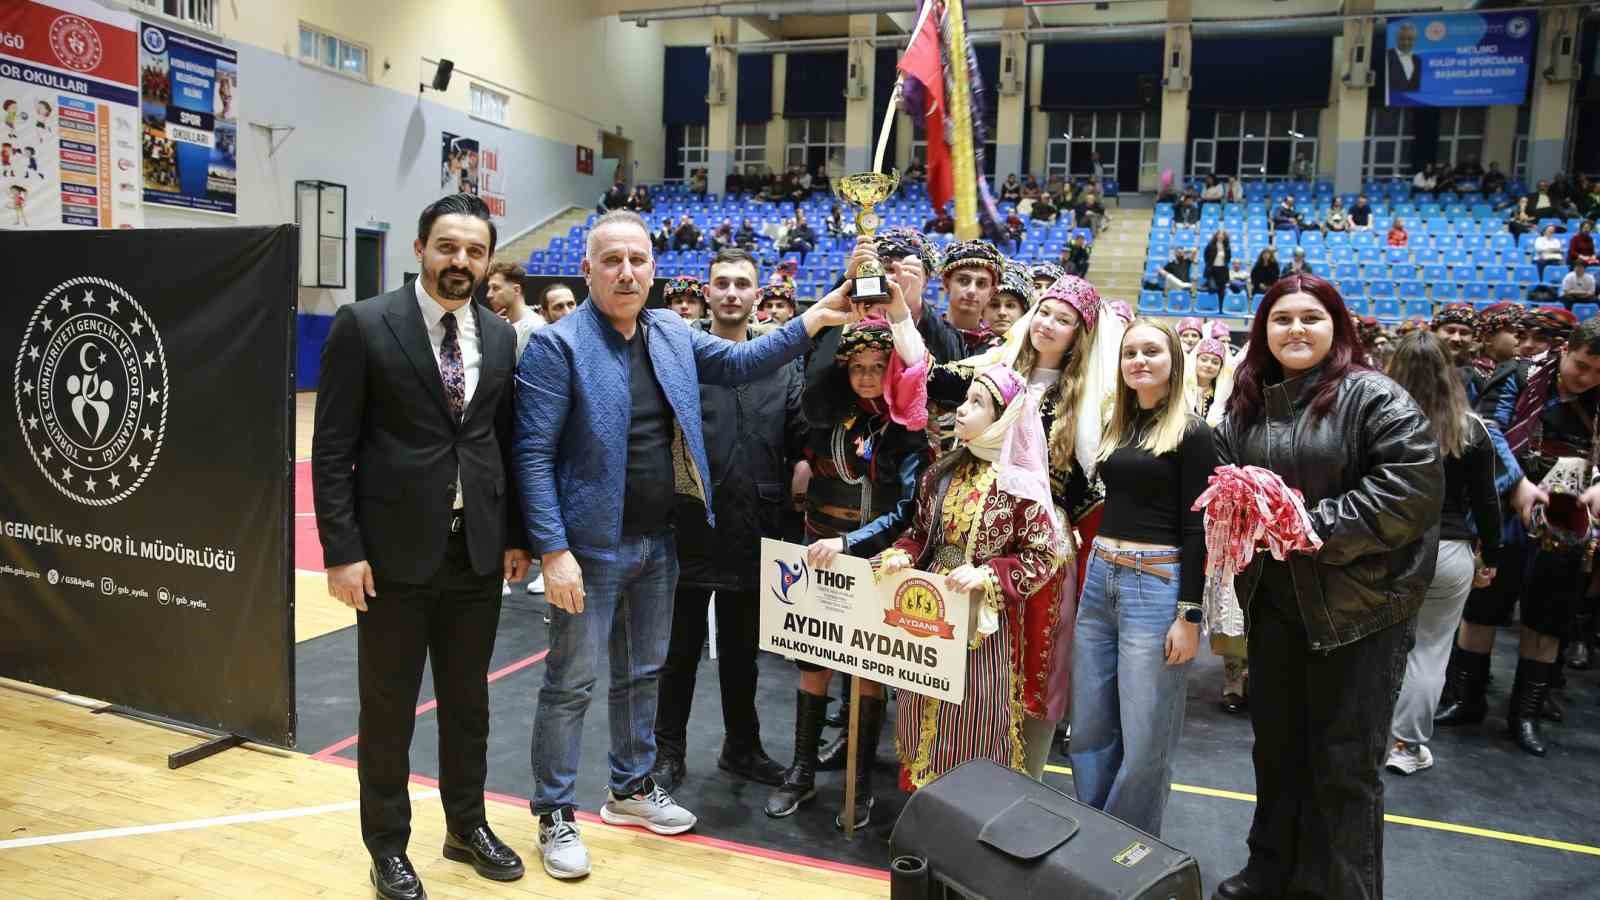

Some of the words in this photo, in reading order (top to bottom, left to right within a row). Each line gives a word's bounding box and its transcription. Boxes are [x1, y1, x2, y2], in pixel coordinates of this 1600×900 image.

[23, 69, 88, 94] OKULLARI
[180, 111, 201, 126] SPOR
[173, 127, 209, 143] OKULLARI
[76, 319, 120, 343] GENÇLİK
[119, 338, 132, 358] VE
[40, 324, 76, 410] CUMHURİYETİ
[126, 358, 140, 397] SPOR
[44, 412, 79, 460] TÜRKİYE
[102, 402, 139, 463] BAKANLIĞI
[4, 521, 64, 546] GENÇLİK
[65, 533, 82, 548] ve
[84, 533, 122, 554] SPOR
[125, 535, 138, 557] İL
[140, 539, 236, 573] MÜDÜRLÜĞÜ
[814, 568, 856, 591] THOF
[783, 612, 844, 644] AYDIN
[850, 628, 938, 668] AYDANS
[898, 617, 940, 632] AYDANS
[771, 635, 858, 667] HALKOYUNLARI
[861, 659, 894, 677] SPOR
[898, 668, 951, 692] KULÜBÜ
